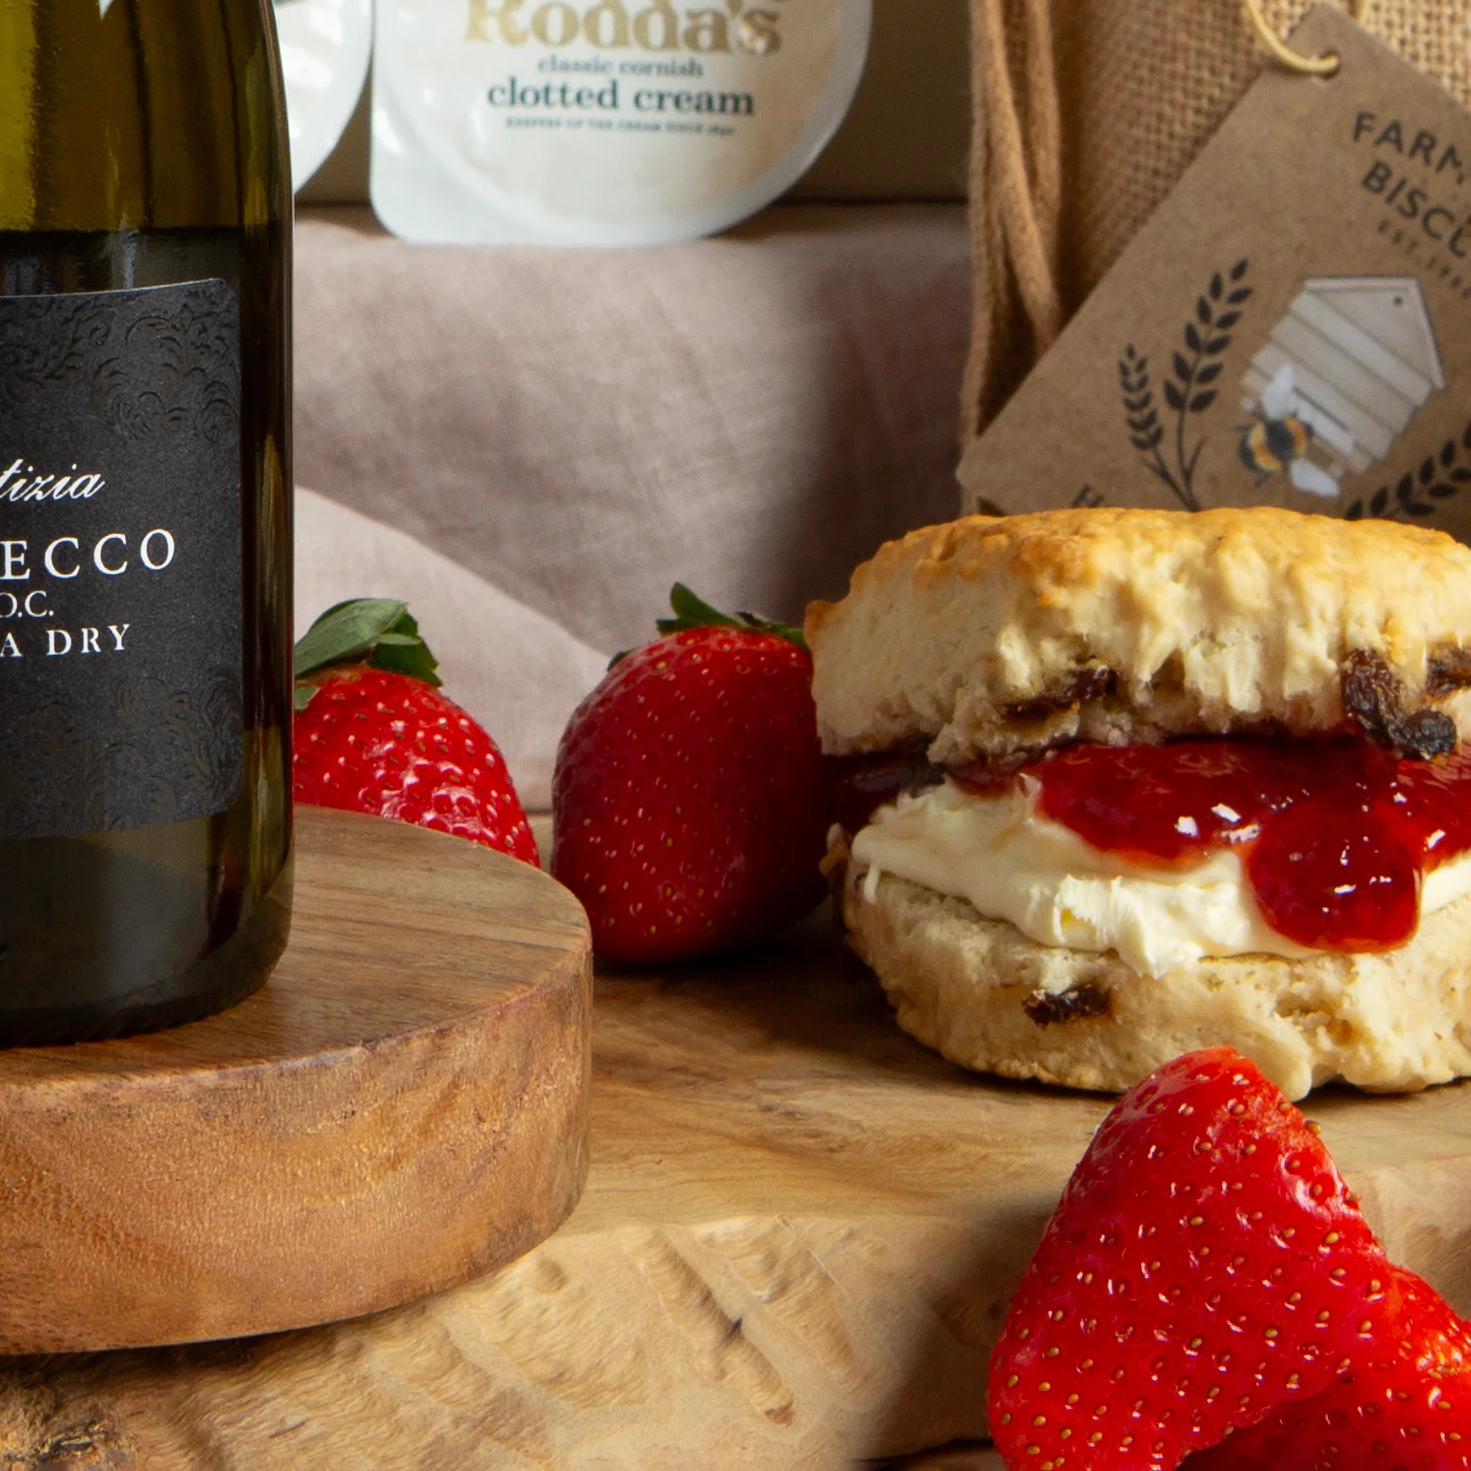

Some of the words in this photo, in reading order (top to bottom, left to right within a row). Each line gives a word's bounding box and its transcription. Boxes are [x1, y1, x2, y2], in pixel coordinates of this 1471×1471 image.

[538, 56, 613, 76] classic
[620, 57, 703, 78] cornish
[488, 76, 619, 109] clotted
[634, 88, 755, 116] cream
[46, 623, 130, 656] DRY
